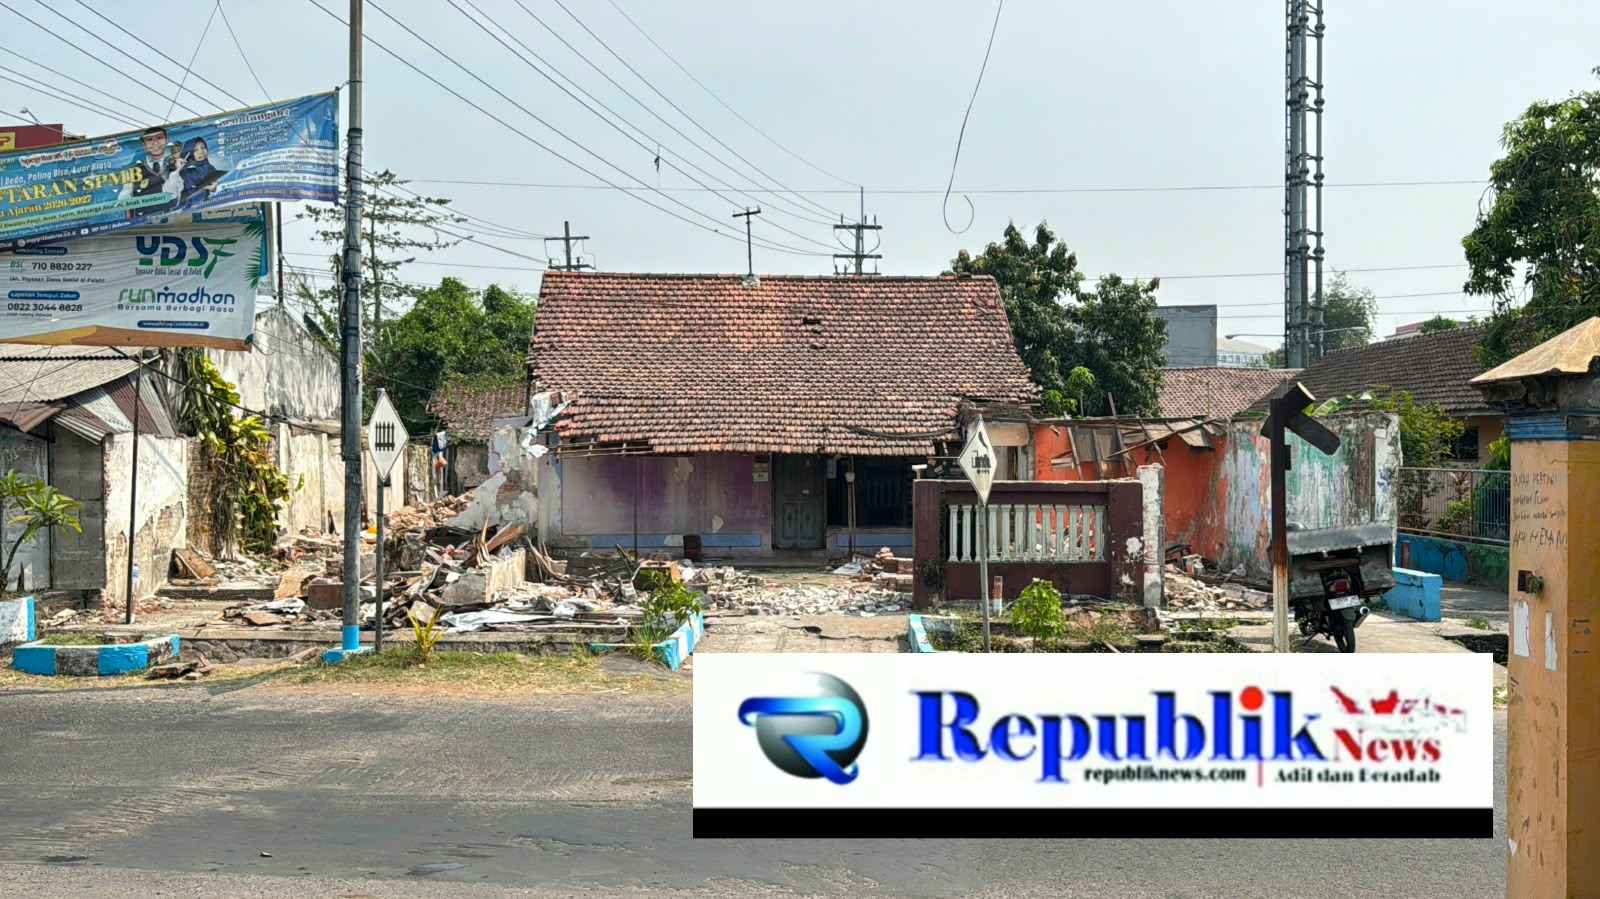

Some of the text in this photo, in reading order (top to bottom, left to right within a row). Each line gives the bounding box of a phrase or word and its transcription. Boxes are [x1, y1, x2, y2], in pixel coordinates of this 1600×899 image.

[28, 171, 52, 184] Paling
[32, 262, 93, 271] 710 8820 227
[8, 303, 31, 311] 0822
[32, 303, 57, 311] 3044
[166, 305, 205, 313] Berbagi
